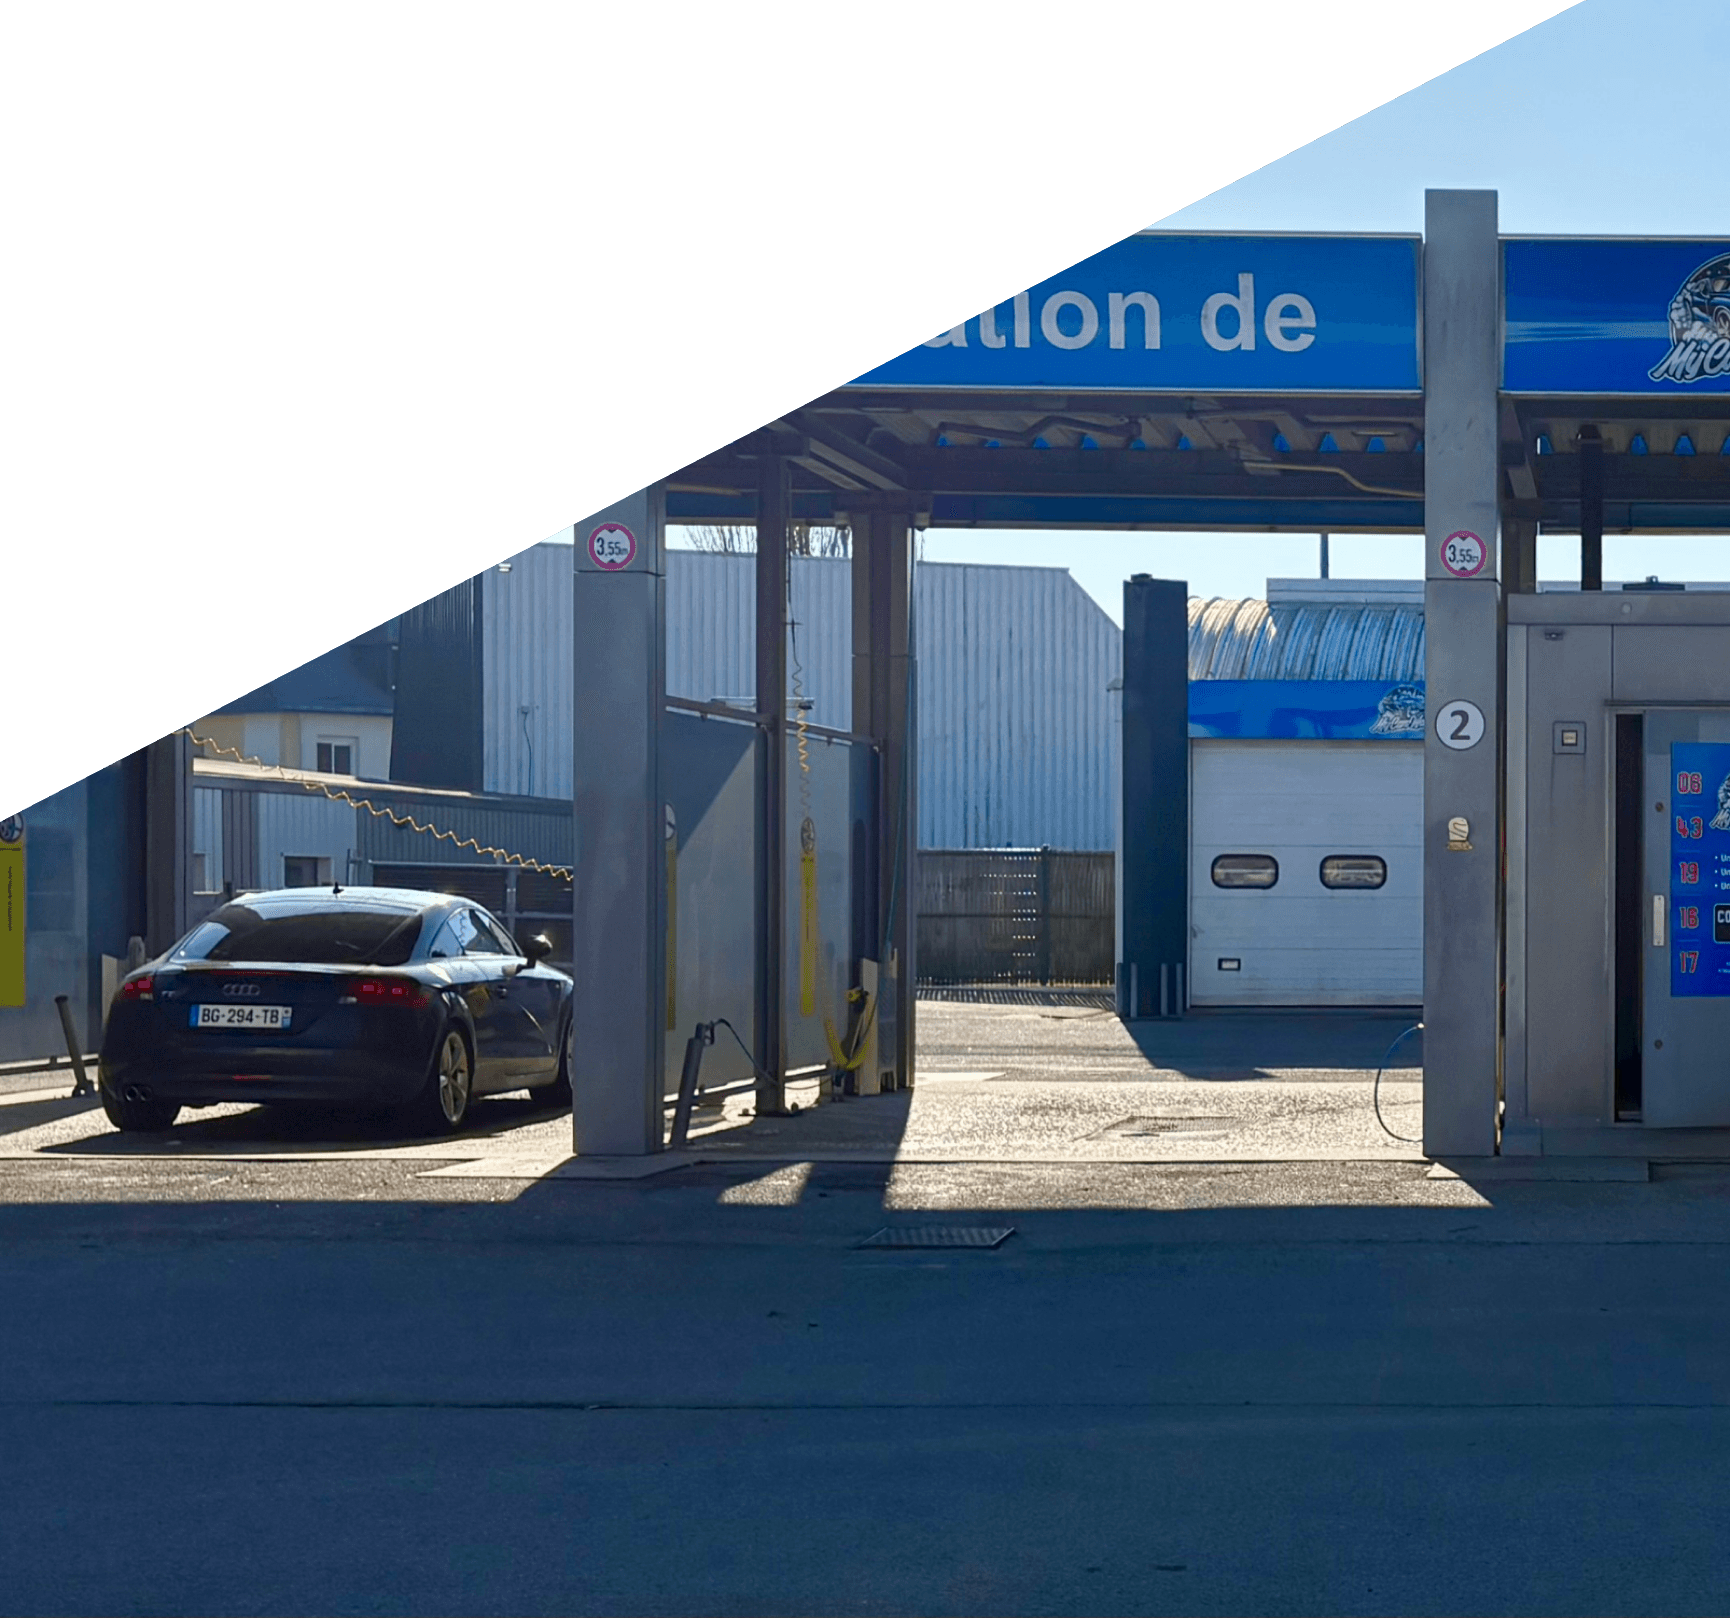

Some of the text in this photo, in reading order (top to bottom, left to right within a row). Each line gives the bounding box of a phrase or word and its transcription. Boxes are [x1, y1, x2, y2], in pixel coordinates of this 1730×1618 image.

[919, 272, 1317, 353] tion de
[1450, 709, 1471, 741] 2
[1677, 771, 1702, 795] 06
[1680, 951, 1699, 974] 17
[201, 1007, 280, 1025] BG-294-TB
